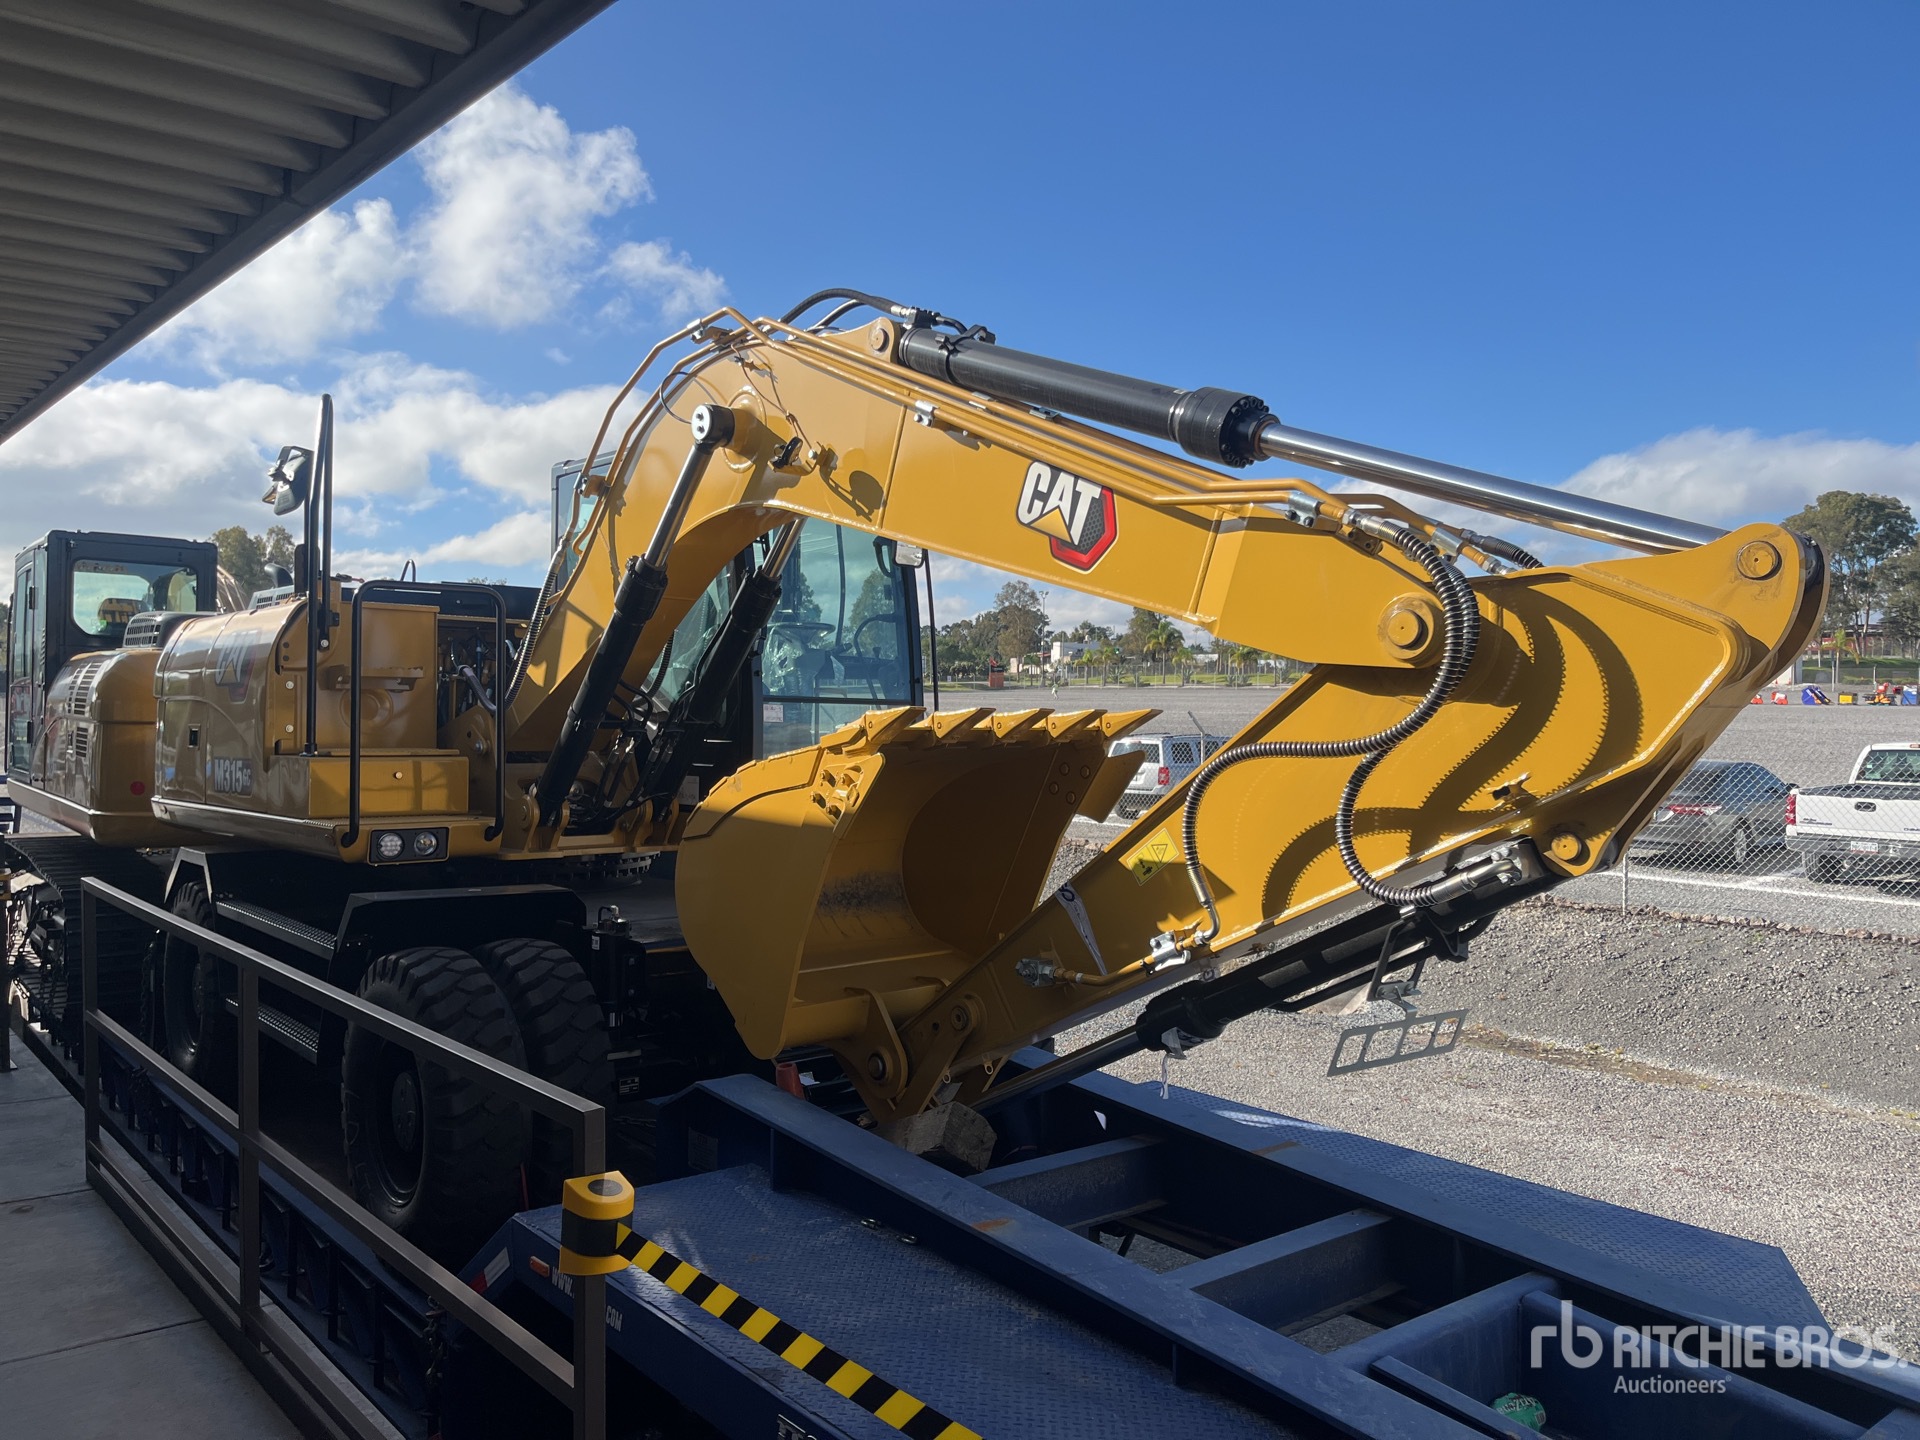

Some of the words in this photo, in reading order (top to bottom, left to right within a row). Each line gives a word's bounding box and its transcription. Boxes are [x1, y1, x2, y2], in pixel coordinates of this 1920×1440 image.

[1018, 461, 1102, 545] CAT
[214, 758, 243, 793] M315
[551, 1266, 575, 1299] WWW.
